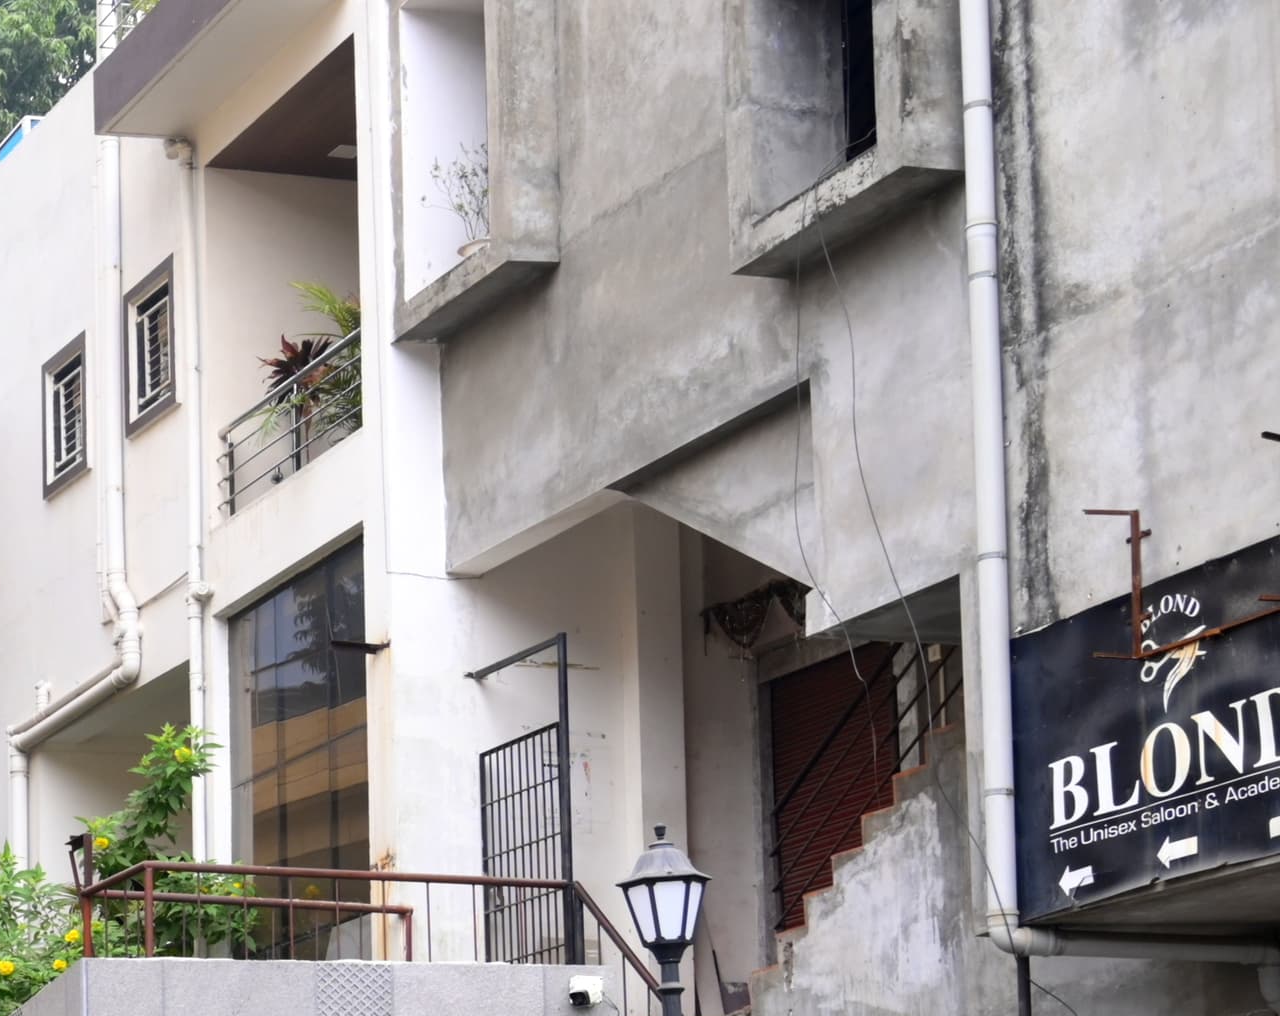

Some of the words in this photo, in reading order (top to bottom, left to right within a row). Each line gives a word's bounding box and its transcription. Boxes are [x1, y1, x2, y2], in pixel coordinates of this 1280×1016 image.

[1050, 835, 1079, 855] The
[1081, 820, 1138, 846] Unisex
[1141, 801, 1199, 829] Saloon
[1204, 791, 1220, 810] &
